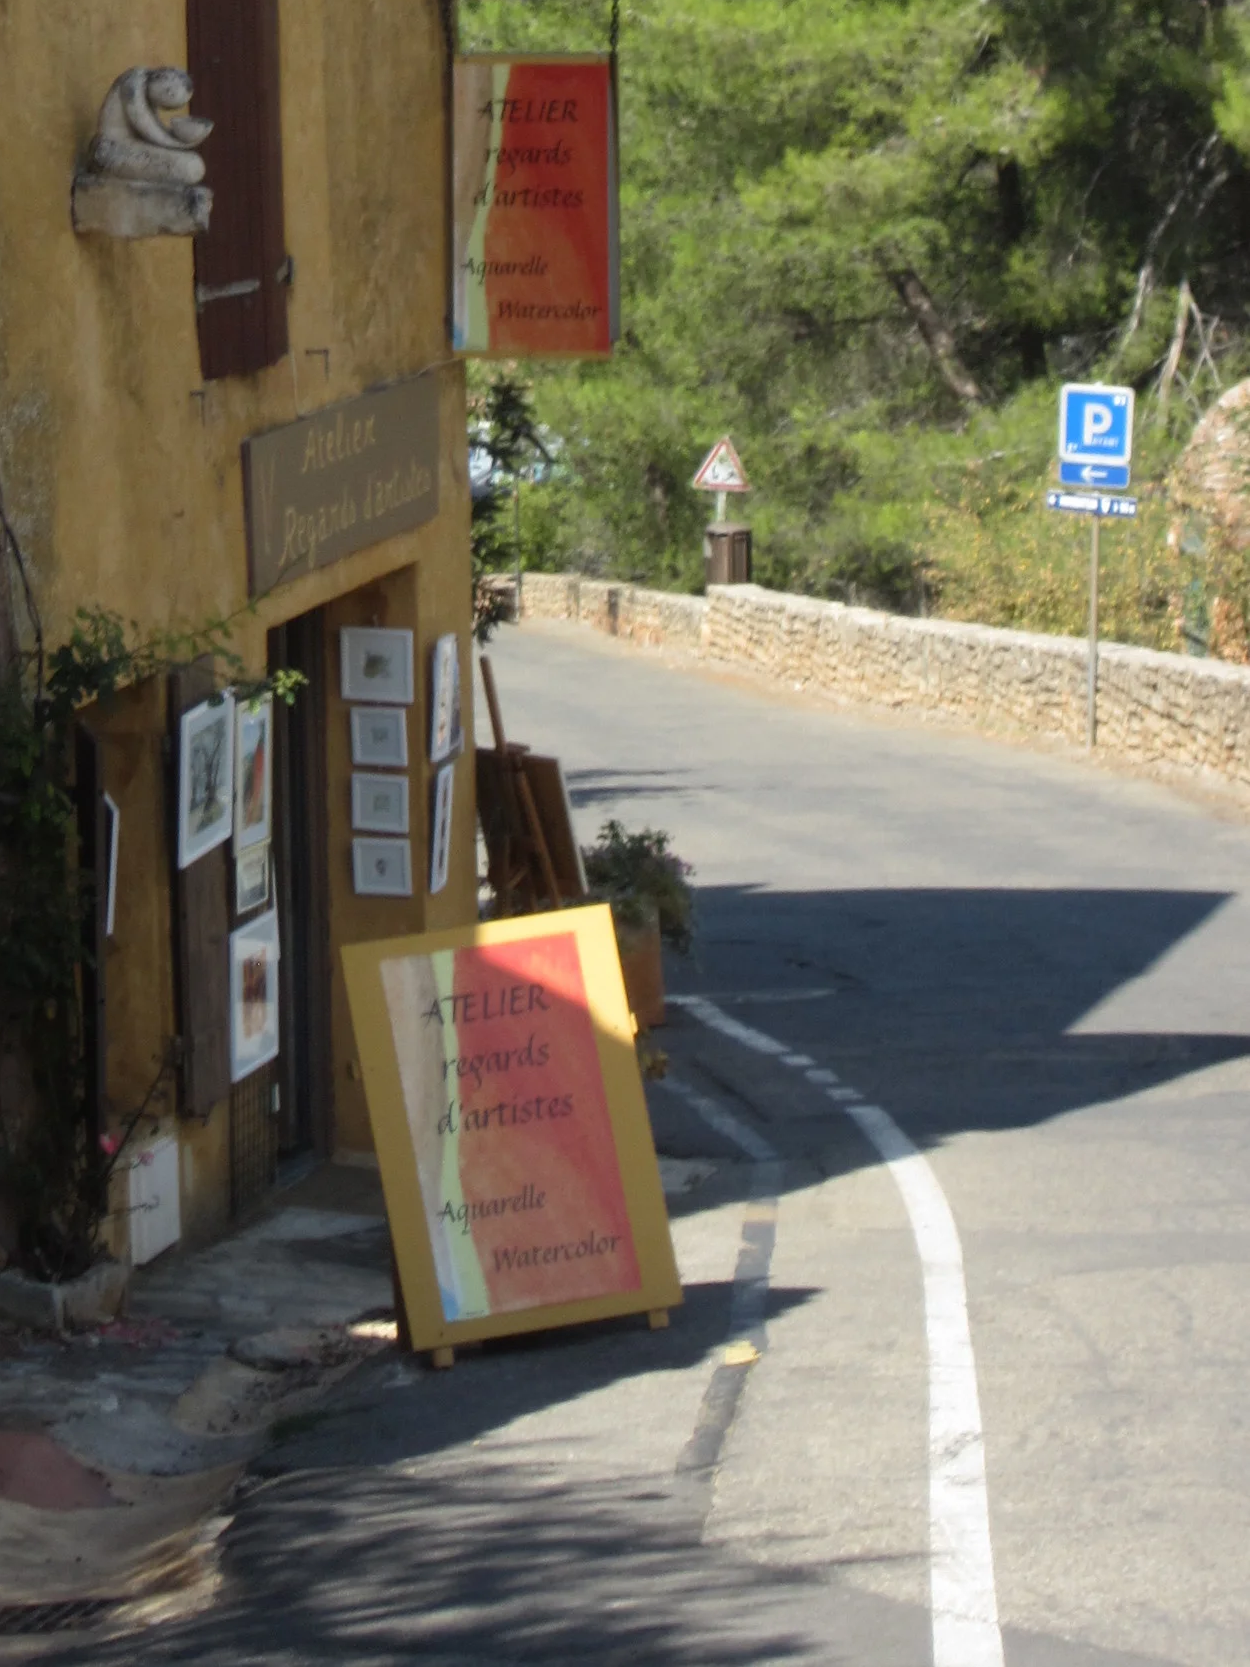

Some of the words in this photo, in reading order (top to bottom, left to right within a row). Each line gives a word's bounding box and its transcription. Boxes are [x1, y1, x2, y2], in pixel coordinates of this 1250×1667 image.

[477, 100, 579, 123] ATELIER
[485, 139, 573, 173] regards
[473, 182, 584, 209] d'artistes
[461, 255, 549, 285] Aquarelle
[498, 300, 602, 321] Watercolor
[302, 411, 376, 474] Atelier
[422, 983, 550, 1026] ATELIER
[442, 1036, 550, 1084] regards
[437, 1093, 574, 1135] d'artistes
[437, 1185, 546, 1233] Aquarelle
[492, 1231, 622, 1271] Watercolor
